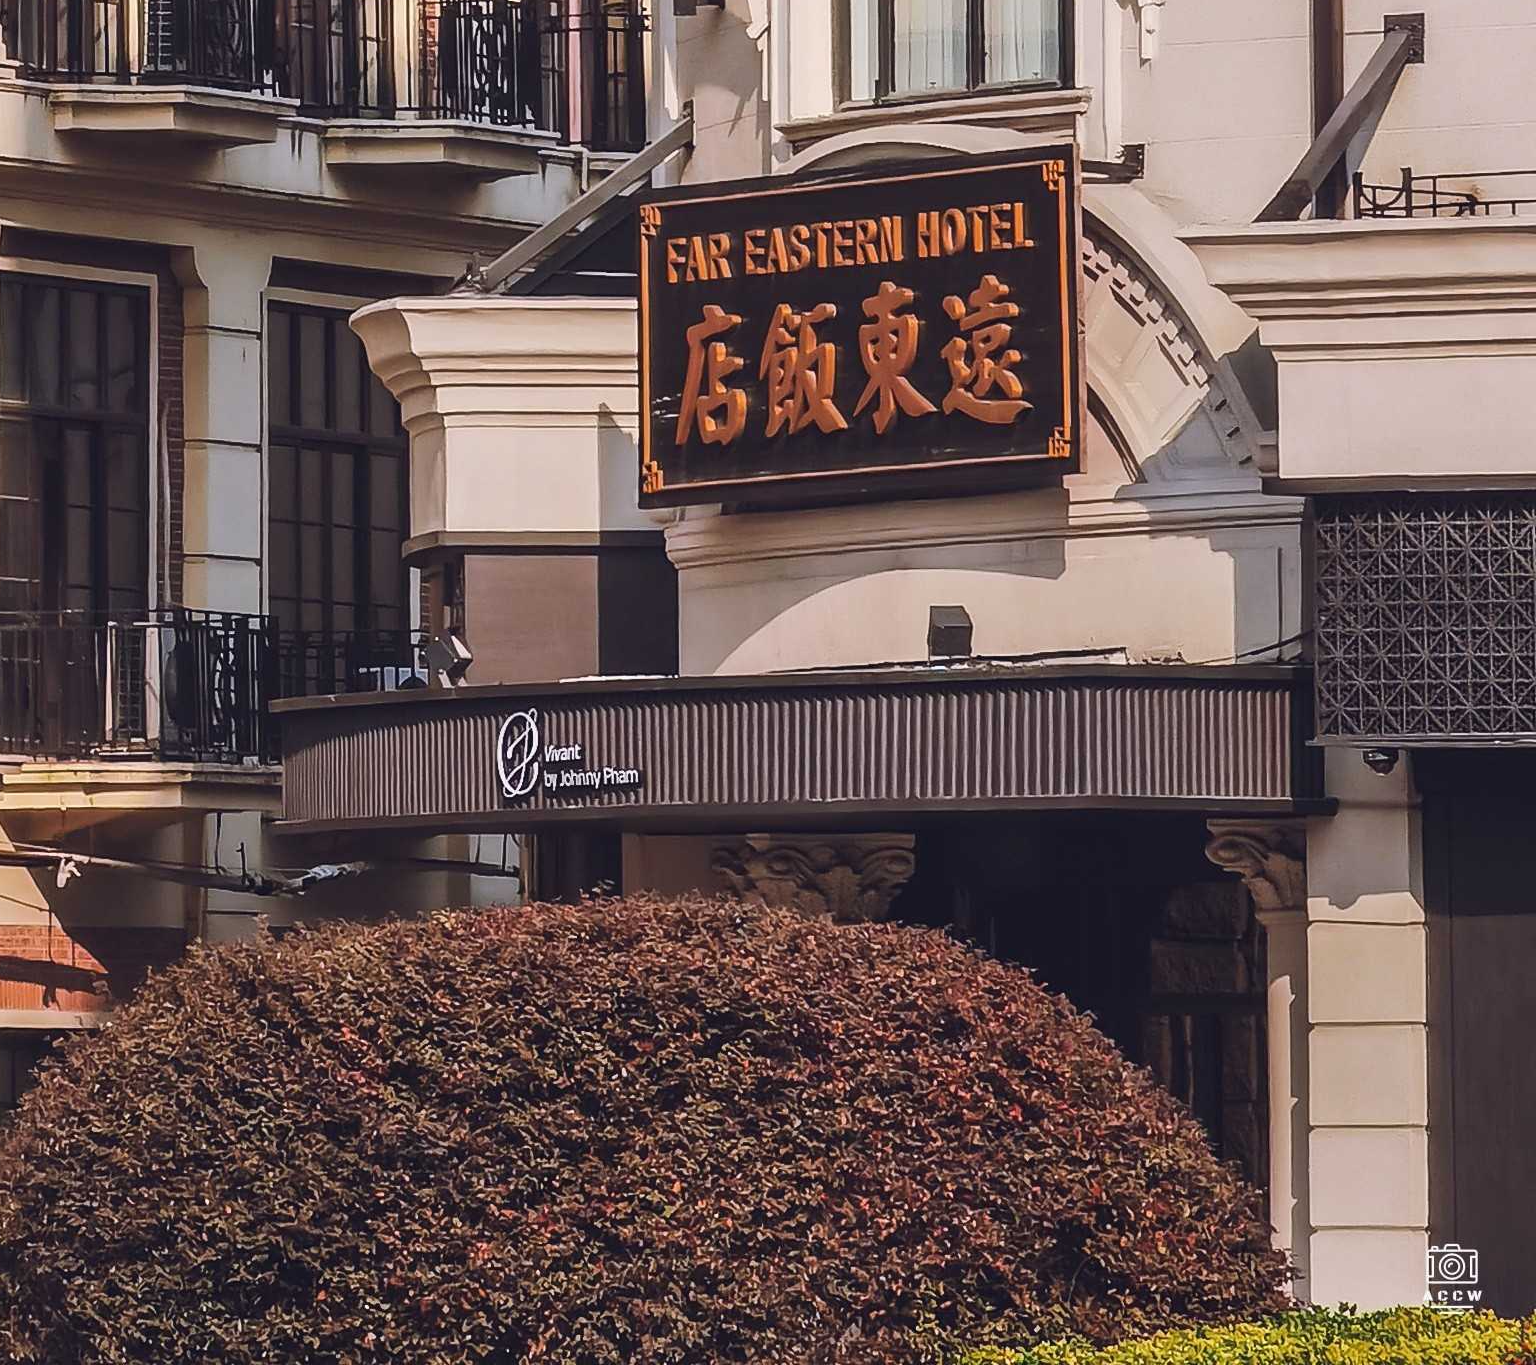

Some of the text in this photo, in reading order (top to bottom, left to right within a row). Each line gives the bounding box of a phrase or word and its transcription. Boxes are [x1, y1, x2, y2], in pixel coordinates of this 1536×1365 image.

[667, 202, 1034, 284] FAR EASTERN HOTEL
[544, 744, 582, 762] Vivant
[544, 767, 639, 791] by Johnny Pham
